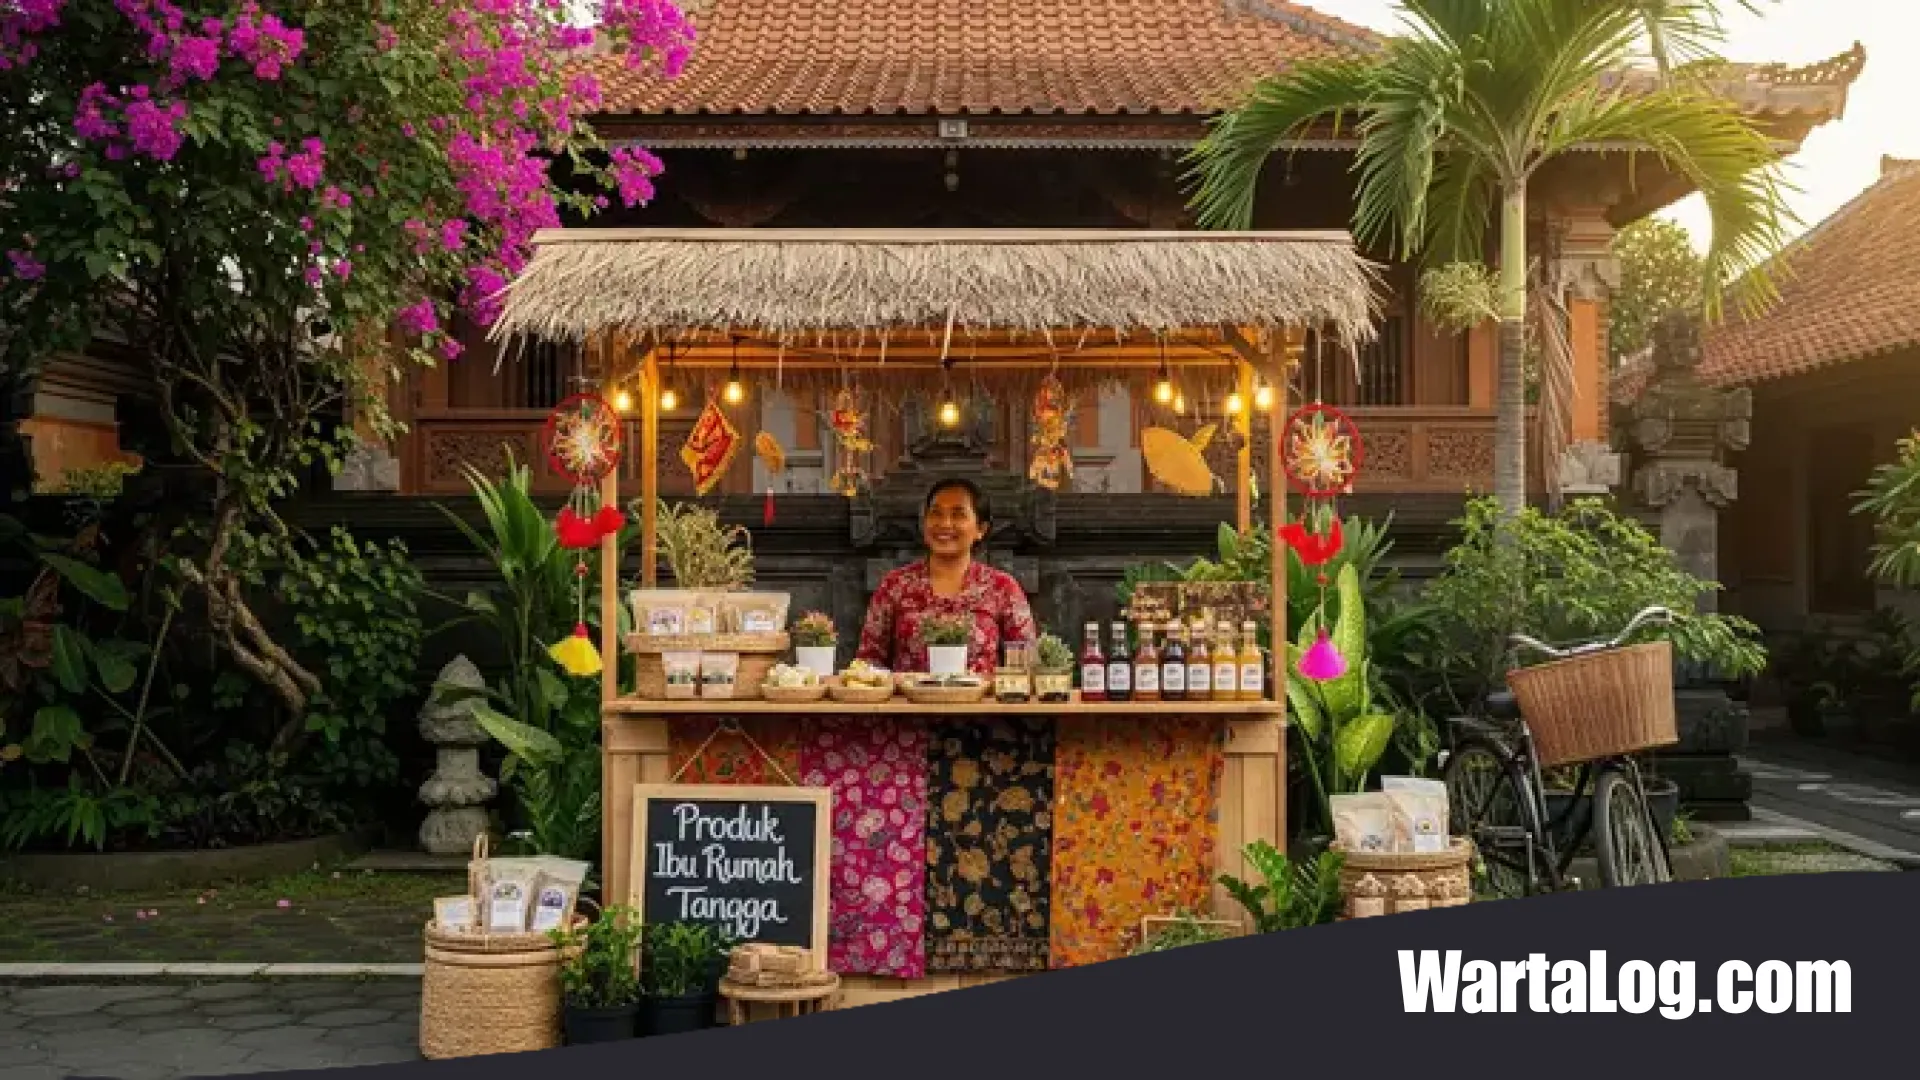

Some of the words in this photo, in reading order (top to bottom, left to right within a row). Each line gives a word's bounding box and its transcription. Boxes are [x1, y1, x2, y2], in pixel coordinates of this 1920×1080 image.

[673, 803, 785, 844] Produk
[653, 841, 699, 878] Ibu
[702, 843, 802, 884] Rumah
[665, 886, 788, 938] Tangga
